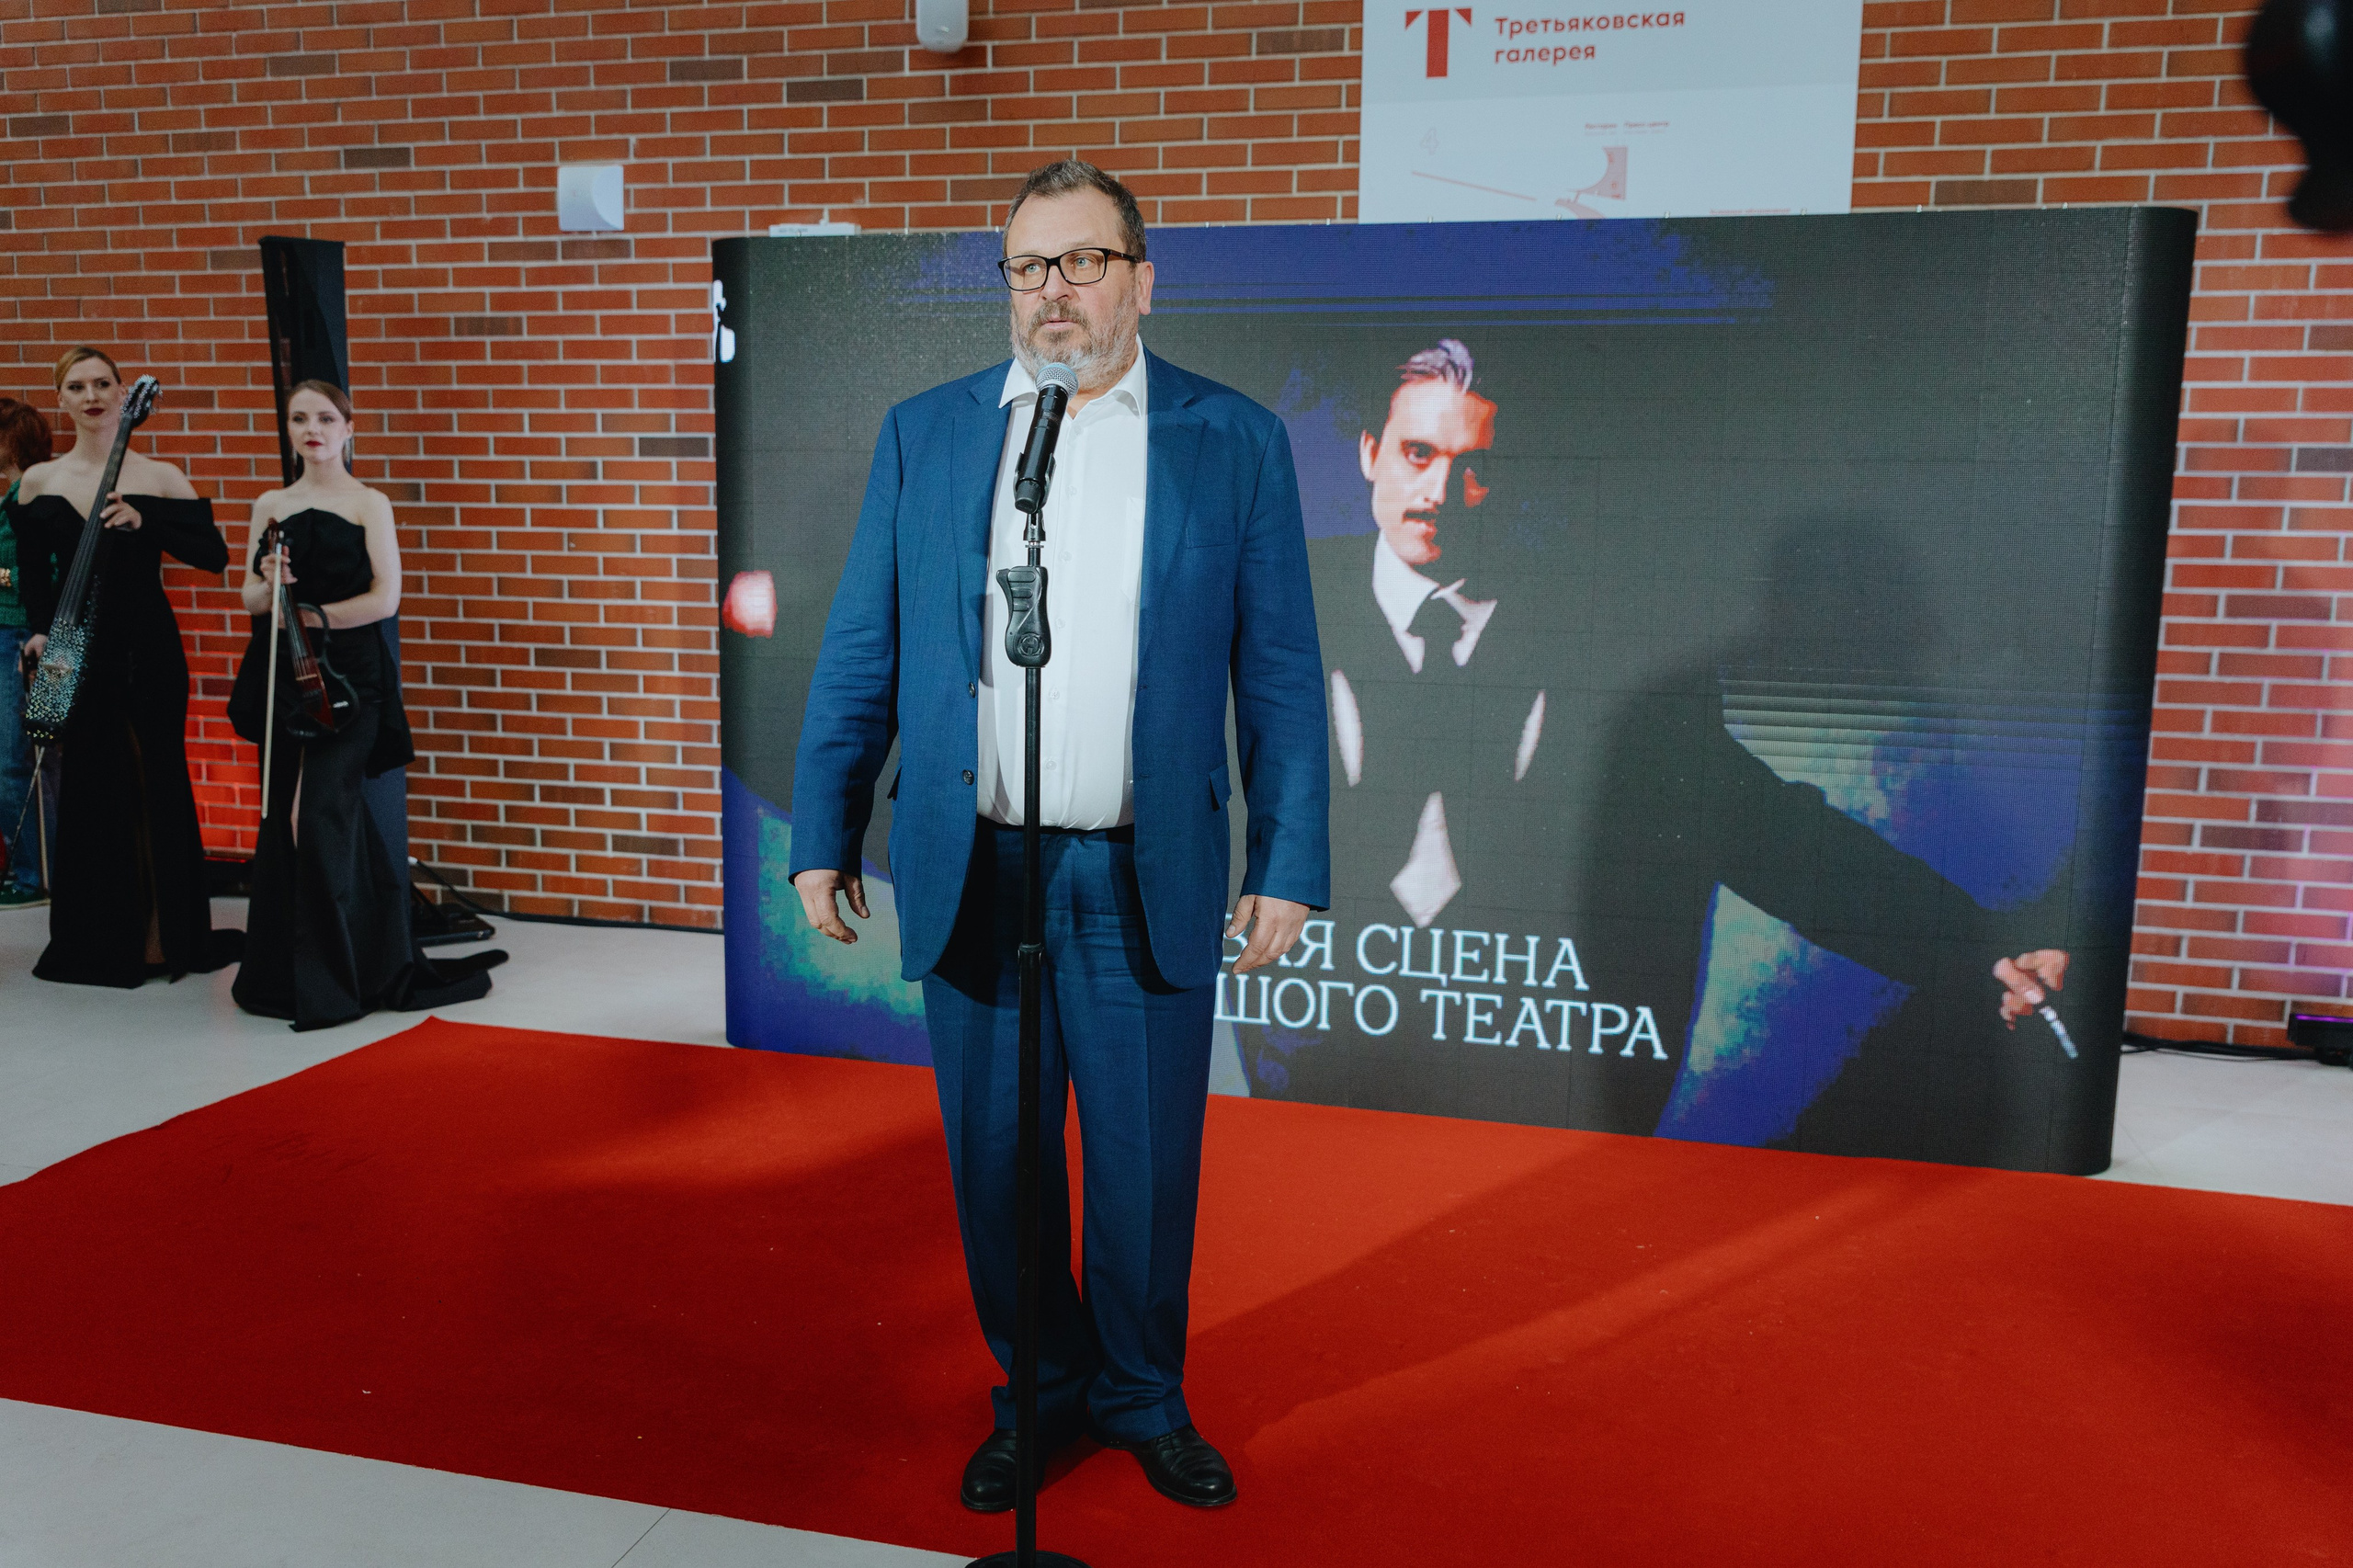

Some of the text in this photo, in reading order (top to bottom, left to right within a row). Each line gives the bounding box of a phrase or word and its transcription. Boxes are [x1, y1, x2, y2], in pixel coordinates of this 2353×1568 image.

[1495, 9, 1686, 40] Третьяковская
[1495, 43, 1597, 66] галерея
[1356, 922, 1590, 991] СЦЕНА
[1420, 987, 1668, 1060] ТЕАТРА
